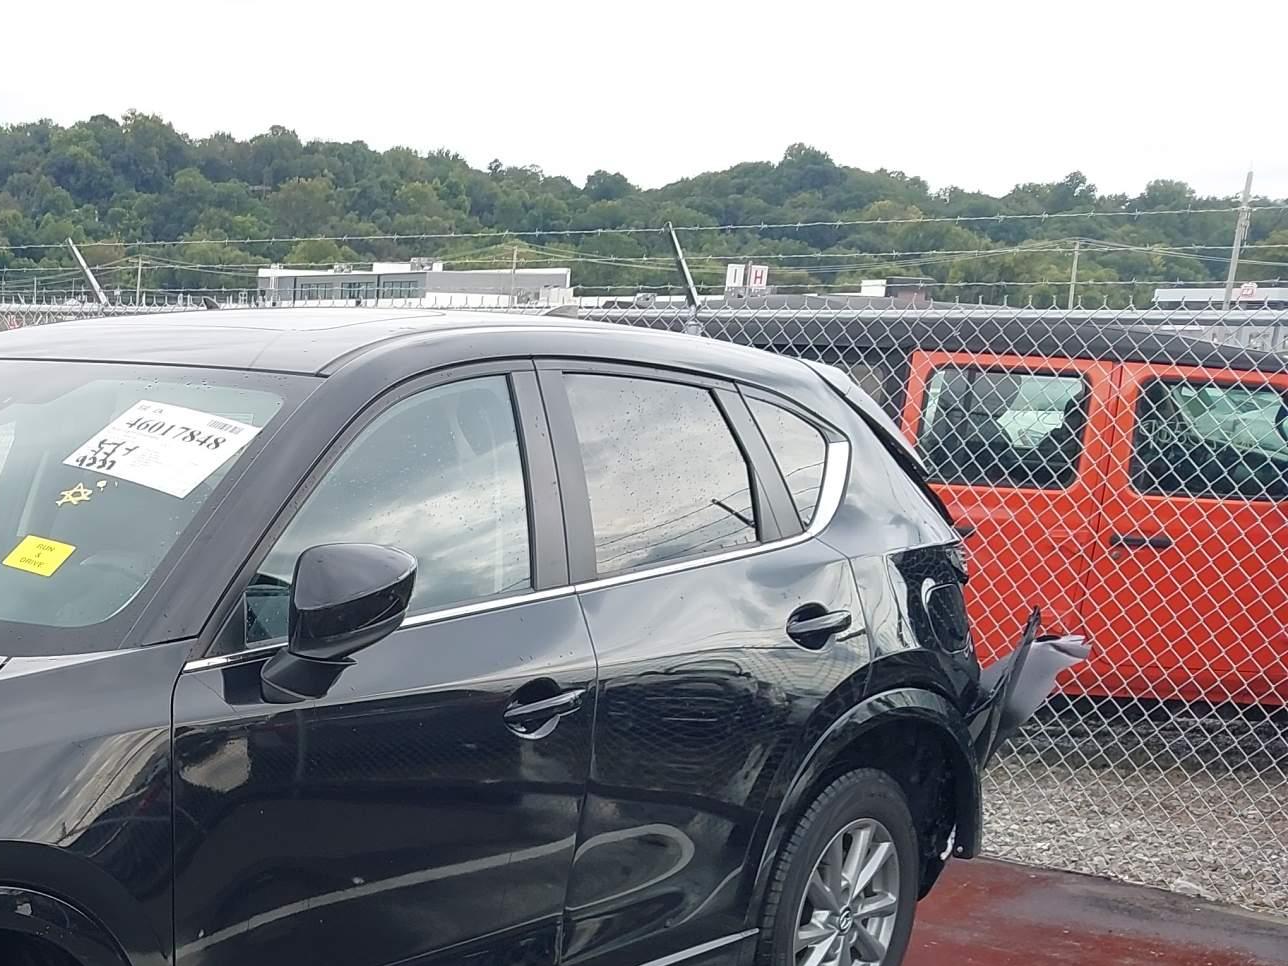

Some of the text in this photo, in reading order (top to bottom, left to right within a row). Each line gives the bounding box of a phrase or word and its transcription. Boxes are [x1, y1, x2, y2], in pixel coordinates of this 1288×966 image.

[753, 269, 764, 285] H
[125, 416, 227, 451] 46017848
[36, 543, 56, 552] RUN
[19, 556, 48, 568] DRIVE
